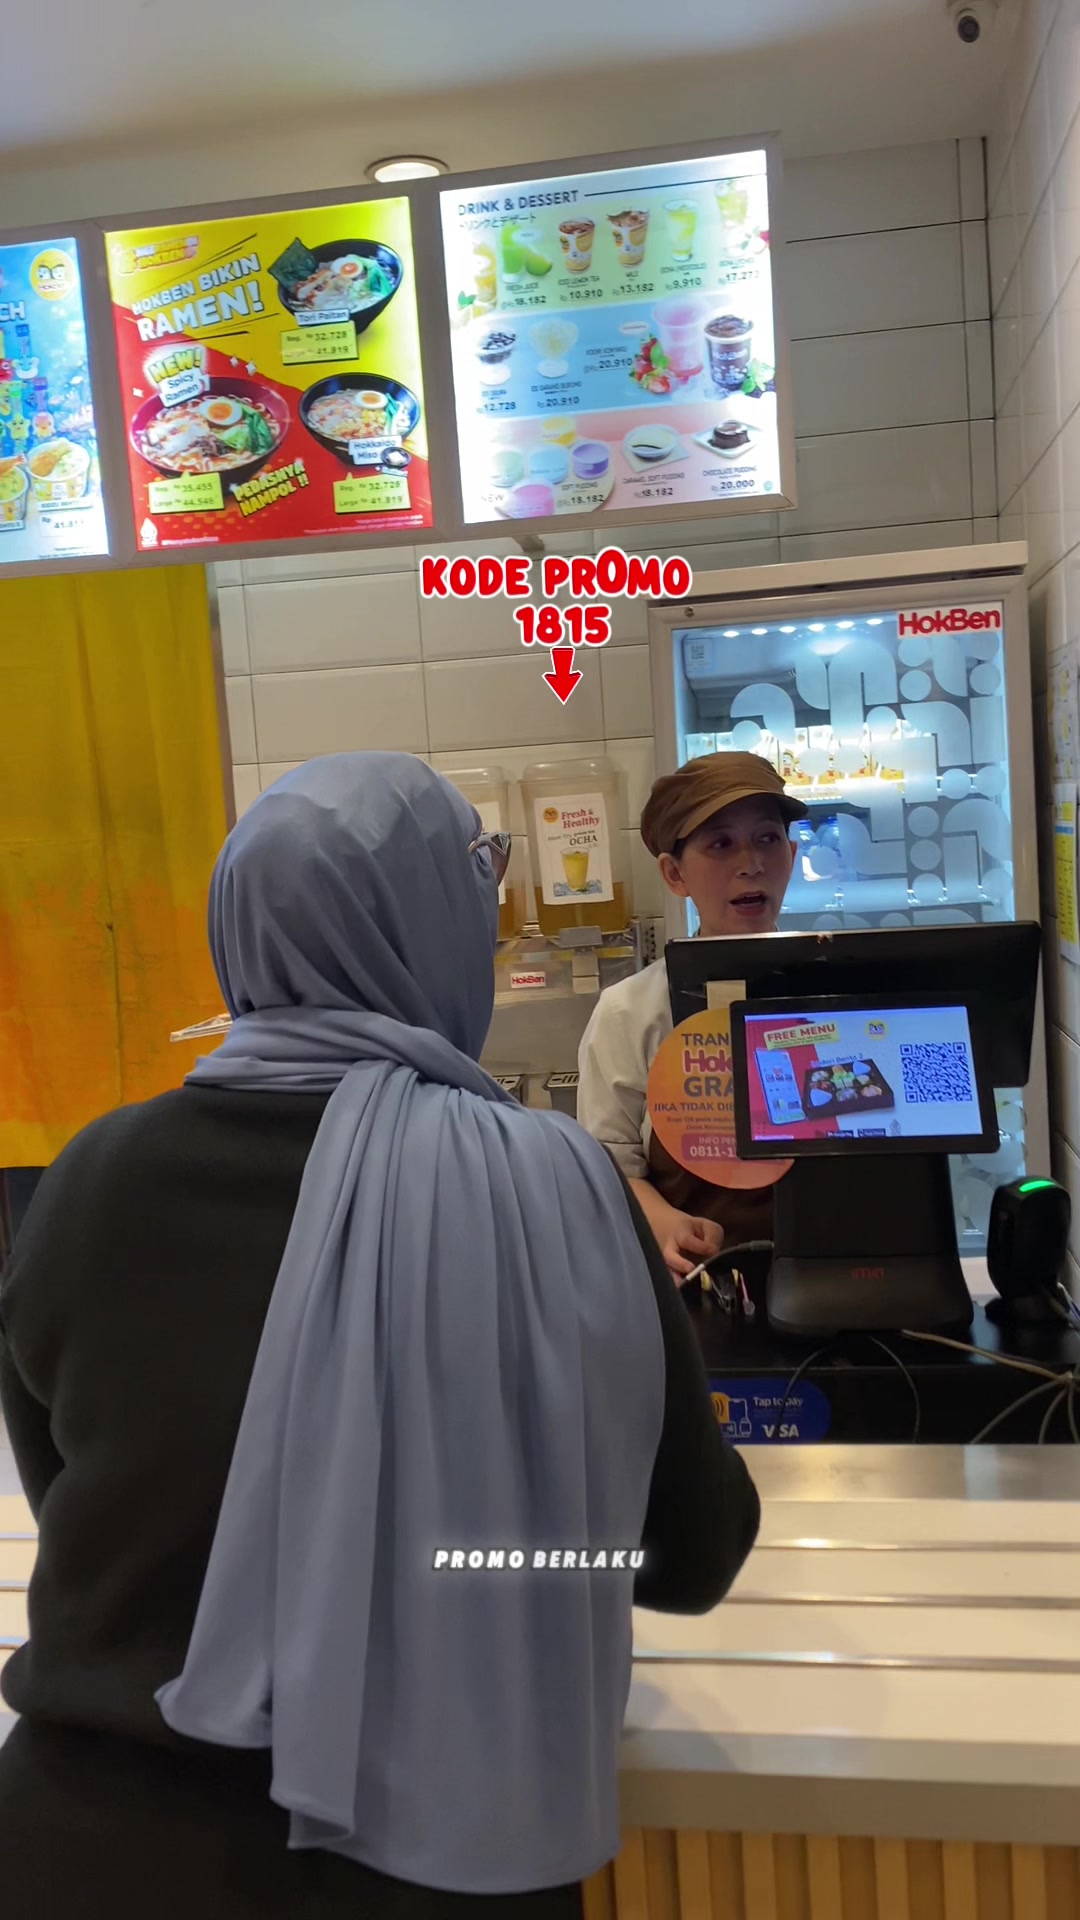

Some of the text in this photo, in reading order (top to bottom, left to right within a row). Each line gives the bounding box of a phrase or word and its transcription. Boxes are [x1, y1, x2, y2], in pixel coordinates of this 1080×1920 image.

[458, 190, 578, 215] DRINK & DESSERT
[131, 280, 195, 315] HOKBEN
[198, 253, 261, 291] BIKIN
[620, 283, 654, 294] 13.182
[673, 277, 702, 289] 9.910
[569, 288, 603, 299] 10.910
[136, 280, 264, 341] RAMEN!
[148, 347, 202, 383] NEW!
[599, 358, 633, 369] 20.910
[168, 374, 193, 389] Spicy
[165, 384, 199, 401] Ramen
[484, 401, 516, 411] 12.728
[546, 396, 580, 407] 20.910
[233, 462, 306, 500] PEDASNYA
[720, 479, 755, 490] 20.000
[641, 487, 674, 497] 18.182
[571, 494, 604, 504] 18.182
[899, 608, 1000, 636] HokBen
[561, 809, 586, 820] Fresh
[563, 817, 600, 829] Healthy
[569, 835, 598, 846] OCHA
[767, 1030, 797, 1041] FREE
[800, 1023, 836, 1037] MENU
[654, 1103, 677, 1112] JIKA
[680, 1102, 714, 1112] TIDAK
[753, 1396, 772, 1407] Tap
[762, 1424, 799, 1438] VSA
